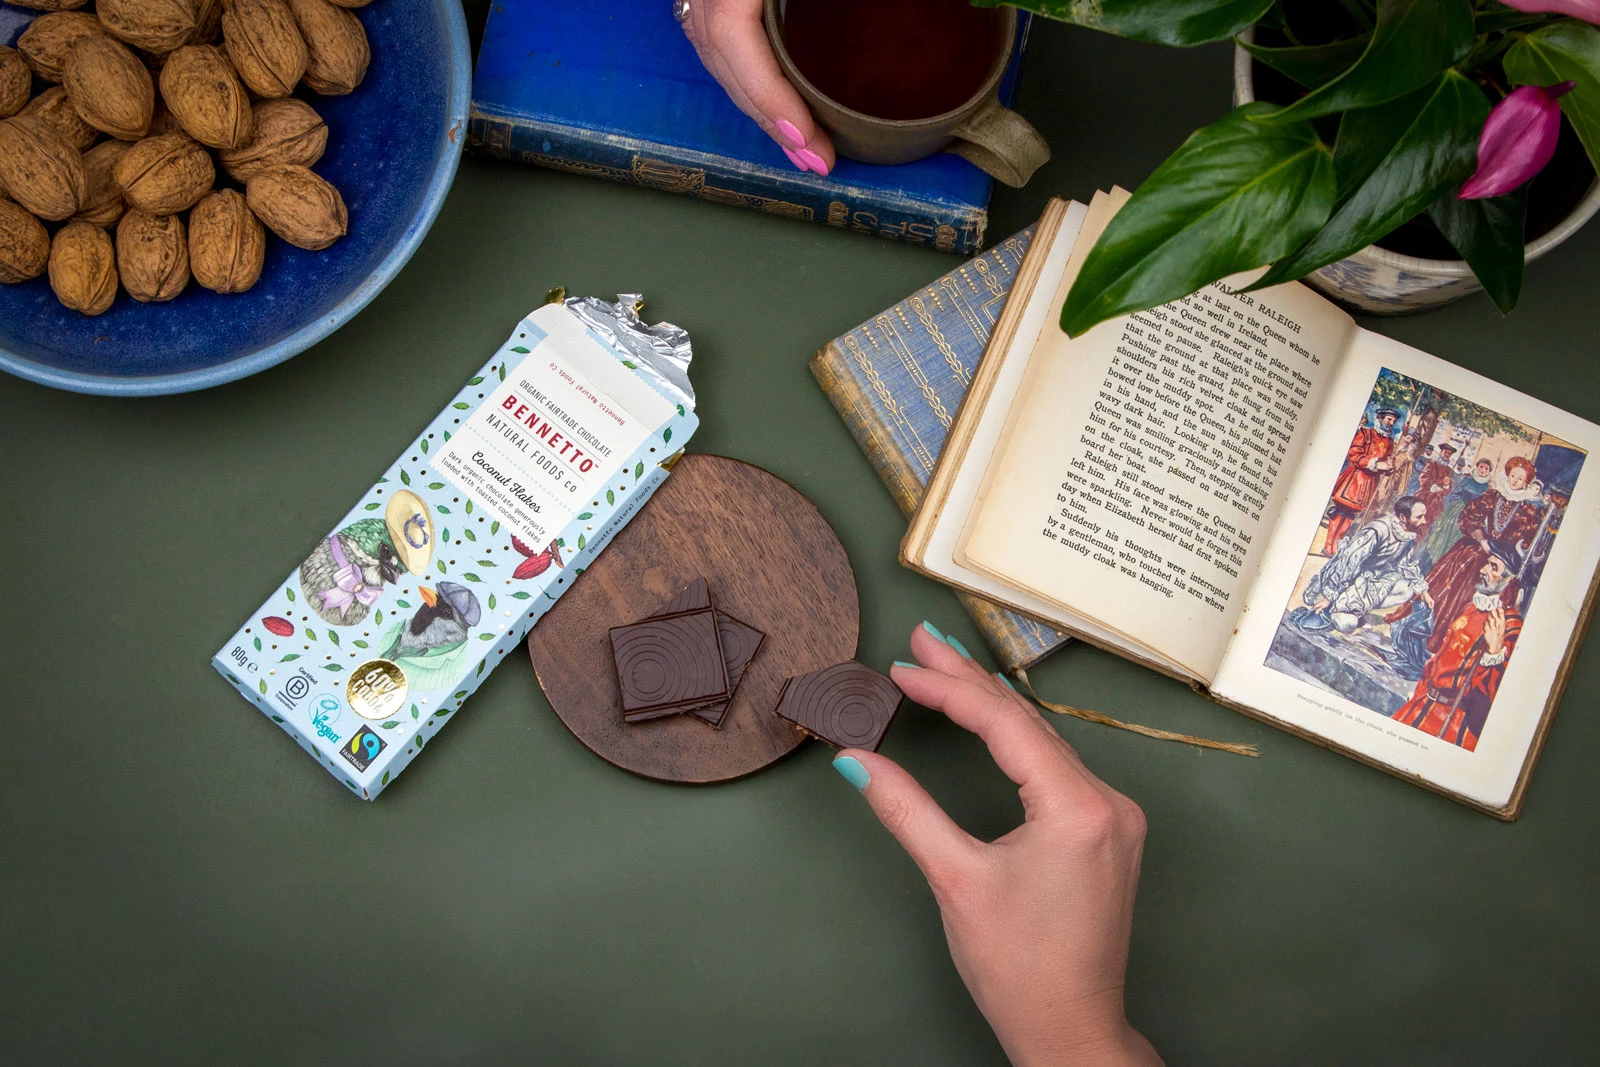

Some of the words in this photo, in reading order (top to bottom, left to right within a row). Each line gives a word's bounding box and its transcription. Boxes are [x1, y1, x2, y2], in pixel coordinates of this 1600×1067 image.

[1144, 308, 1168, 321] eigh
[1169, 318, 1194, 334] stood
[1194, 330, 1210, 342] she
[1209, 339, 1243, 360] glanced
[1243, 357, 1253, 366] at
[1254, 361, 1267, 374] the
[1267, 370, 1295, 390] ground
[1294, 387, 1308, 399] and
[1180, 308, 1207, 328] Queen
[1210, 324, 1231, 340] drew
[1233, 337, 1252, 351] near
[1254, 348, 1268, 360] the
[1269, 357, 1290, 373] place
[1292, 370, 1312, 388] where
[1193, 303, 1204, 312] so
[1207, 309, 1225, 323] well
[1226, 318, 1235, 329] in
[1238, 324, 1268, 348] Ireland.
[1202, 294, 1212, 304] at
[1214, 299, 1231, 313] last
[1233, 310, 1244, 320] on
[1246, 316, 1260, 329] the
[1262, 325, 1287, 344] Queen
[1289, 341, 1310, 359] whom
[1311, 354, 1320, 366] he
[1258, 303, 1302, 334] RALEIGH
[550, 362, 558, 370] Co
[559, 370, 575, 385] Foods
[576, 385, 598, 404] Natural
[1116, 346, 1158, 370] shoulders
[1161, 366, 1175, 379] his
[1178, 376, 1196, 390] rich
[1200, 387, 1224, 404] velvet
[1226, 401, 1248, 417] cloak
[1250, 415, 1266, 427] and
[1267, 425, 1291, 444] spread
[1121, 333, 1158, 358] Pushing
[1159, 354, 1179, 368] past
[1181, 363, 1196, 376] the
[1197, 373, 1224, 393] guard,
[1228, 387, 1239, 399] he
[1242, 395, 1263, 413] flung
[1265, 408, 1282, 424] from
[1284, 420, 1295, 432] his
[1129, 312, 1162, 332] seemed
[1164, 328, 1174, 338] to
[1175, 335, 1203, 353] pause.
[1212, 351, 1250, 377] Raleigh's
[1252, 375, 1273, 391] quick
[1275, 389, 1288, 400] eye
[1289, 397, 1303, 409] saw
[486, 414, 529, 452] NATURAL
[530, 450, 564, 480] FOODS
[501, 394, 593, 473] BENNETTO
[519, 380, 547, 403] ORGANIC
[545, 400, 578, 430] FAIRTRADE
[577, 427, 611, 457] CHOCOLATE
[599, 403, 625, 426] Bennetto
[1107, 366, 1136, 386] bowed
[1137, 381, 1154, 394] low
[1154, 389, 1181, 409] before
[1183, 404, 1197, 417] the
[1199, 412, 1226, 434] Queen,
[1228, 427, 1241, 440] his
[1241, 437, 1270, 457] plumed
[1270, 452, 1282, 466] hat
[472, 450, 512, 487] Coconut
[509, 482, 541, 513] Flakes
[1080, 434, 1106, 453] board
[1108, 448, 1124, 461] her
[1126, 456, 1146, 473] boat.
[1094, 401, 1122, 420] Queen
[1125, 417, 1142, 430] was
[1144, 427, 1177, 448] smiling
[1177, 444, 1220, 470] graciously
[1221, 466, 1237, 479] and
[1238, 475, 1269, 500] thanking
[441, 457, 461, 475] loaded
[461, 475, 474, 487] with
[475, 486, 498, 507] toasted
[498, 506, 520, 526] coconut
[522, 525, 541, 543] flakes
[448, 451, 462, 465] Dark
[463, 464, 485, 484] organic
[486, 484, 514, 508] chocolate
[514, 508, 546, 535] generously
[613, 504, 634, 526] Natural
[635, 485, 651, 502] Foods
[652, 476, 660, 484] Co
[1057, 493, 1066, 502] to
[1069, 498, 1087, 514] him.
[1067, 471, 1087, 485] were
[1089, 482, 1132, 508] sparkling.
[1140, 505, 1167, 523] Never
[1169, 520, 1193, 538] would
[1194, 532, 1205, 544] he
[1206, 539, 1229, 558] forget
[1229, 553, 1243, 567] this
[1084, 450, 1118, 473] Raleigh
[1121, 470, 1139, 483] still
[1141, 480, 1165, 496] stood
[1169, 493, 1193, 510] where
[1196, 506, 1210, 519] the
[1213, 515, 1236, 535] Queen
[1238, 530, 1252, 544] had
[1042, 528, 1057, 540] the
[1060, 538, 1091, 557] muddy
[1093, 553, 1117, 569] cloak
[1120, 565, 1137, 578] was
[1139, 573, 1174, 598] hanging.
[1047, 515, 1059, 528] by
[1059, 523, 1066, 531] a
[1068, 528, 1115, 556] gentleman,
[1119, 551, 1136, 564] who
[1139, 560, 1172, 582] touched
[1173, 577, 1186, 590] his
[1187, 587, 1203, 599] arm
[1205, 596, 1225, 613] where
[1060, 508, 1101, 534] Suddenly
[1105, 529, 1119, 542] his
[1124, 539, 1162, 563] thoughts
[1167, 561, 1186, 576] were
[1189, 572, 1230, 601] interrupted
[1061, 481, 1078, 495] day
[1080, 491, 1102, 506] when
[1104, 501, 1145, 527] Elizabeth
[1148, 522, 1178, 543] herself
[1178, 537, 1194, 552] had
[1195, 547, 1212, 562] first
[1213, 559, 1238, 578] spoken
[230, 646, 248, 667] 80g
[298, 666, 318, 685] Certified
[312, 708, 340, 744] Vegan
[352, 679, 384, 714] COCOA
[341, 748, 366, 771] FAIRTRADE
